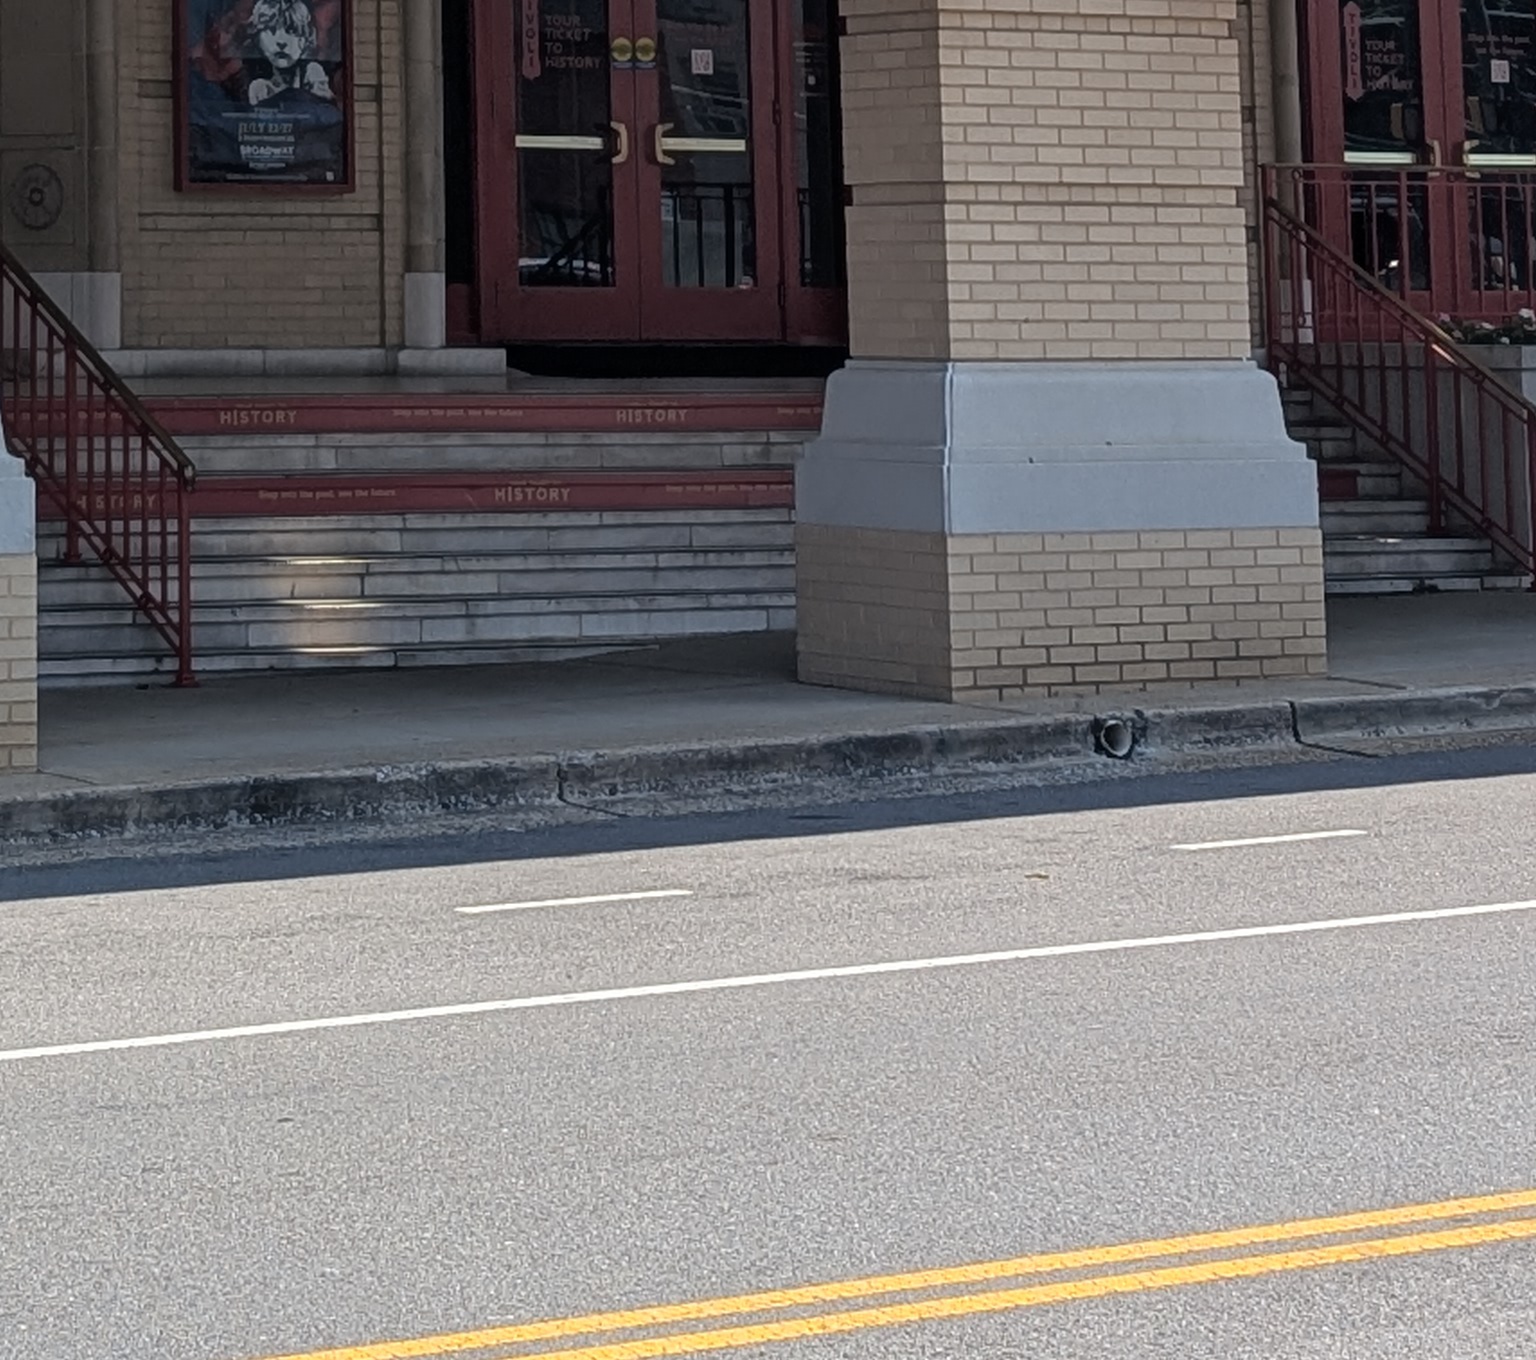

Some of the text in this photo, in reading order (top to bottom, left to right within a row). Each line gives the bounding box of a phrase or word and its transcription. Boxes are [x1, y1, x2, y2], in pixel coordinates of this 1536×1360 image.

[545, 15, 581, 26] YOUR
[544, 27, 592, 41] TICKET
[544, 42, 563, 54] TO
[1365, 65, 1382, 77] TO
[219, 409, 297, 426] HISTORY
[615, 408, 688, 423] HISTORY
[494, 486, 571, 502] HISTORY
